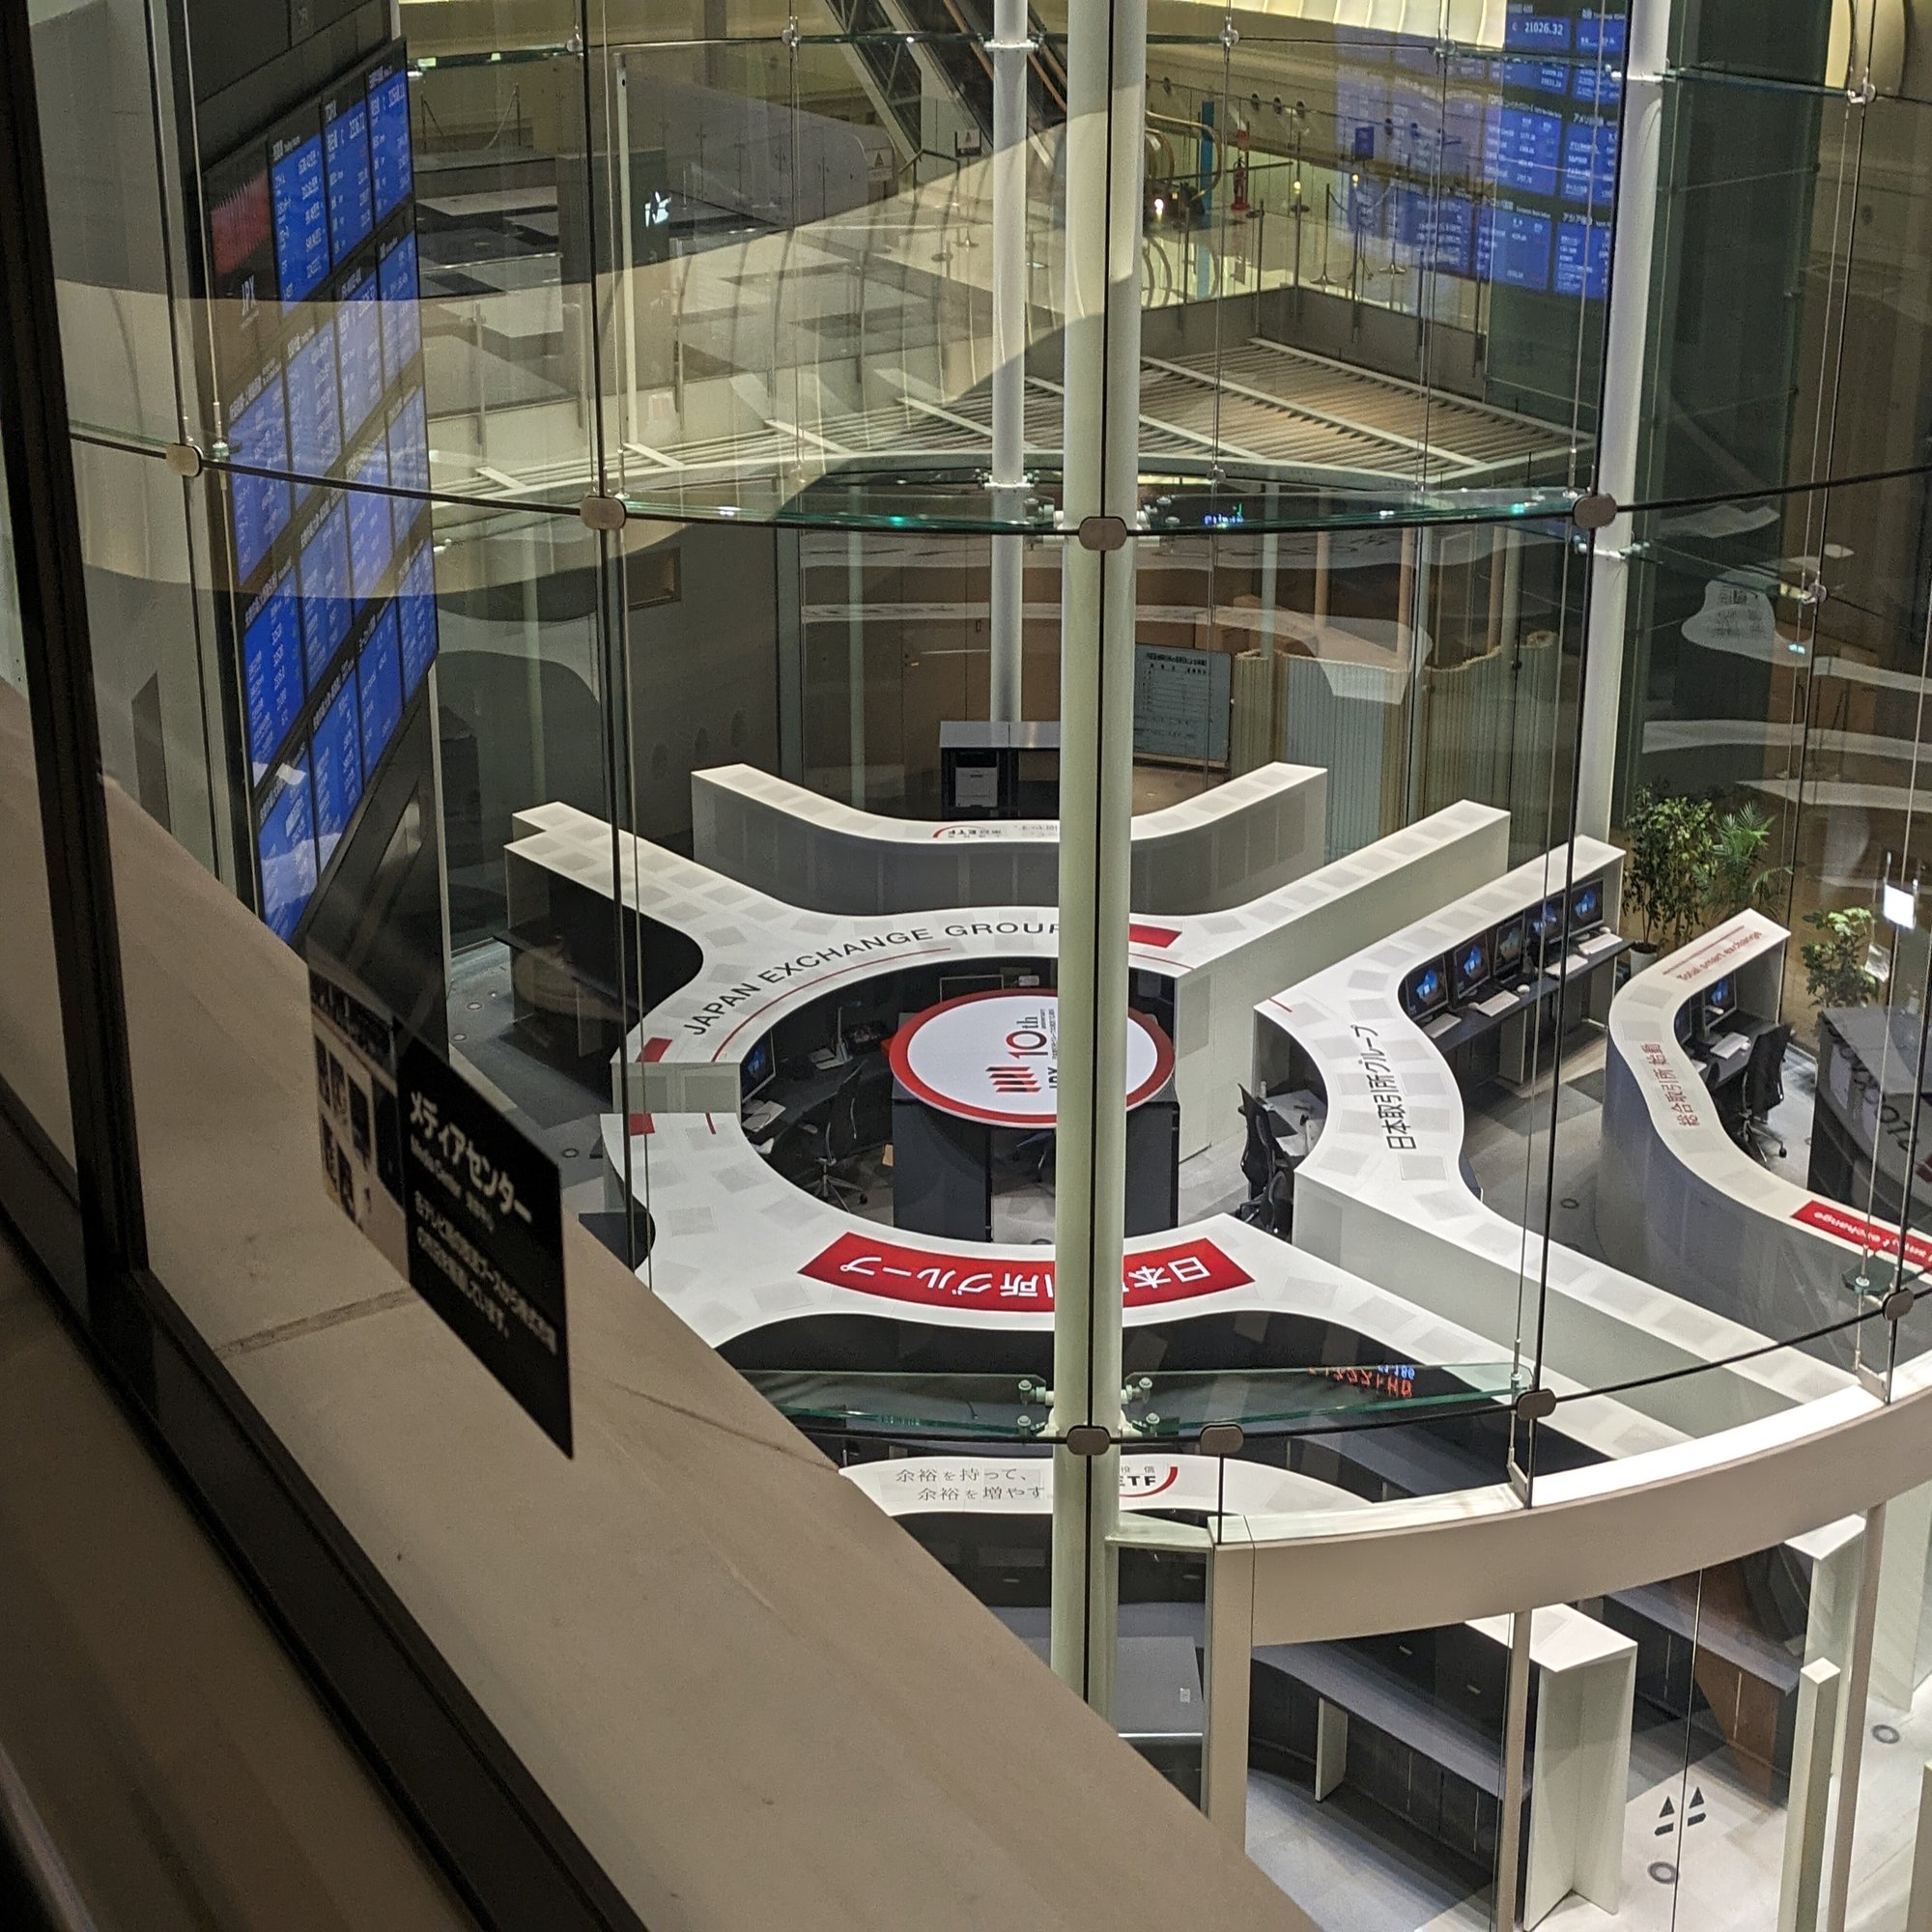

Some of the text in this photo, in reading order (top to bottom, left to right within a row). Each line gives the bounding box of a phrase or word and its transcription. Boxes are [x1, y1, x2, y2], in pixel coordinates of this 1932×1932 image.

[682, 980, 762, 1037] JAPAN
[757, 927, 934, 985] EXCHANGE
[1350, 1024, 1417, 1150] 日本取引所グループ
[410, 1089, 532, 1224] メディアセンター
[839, 1255, 1210, 1299] 日本所グループ
